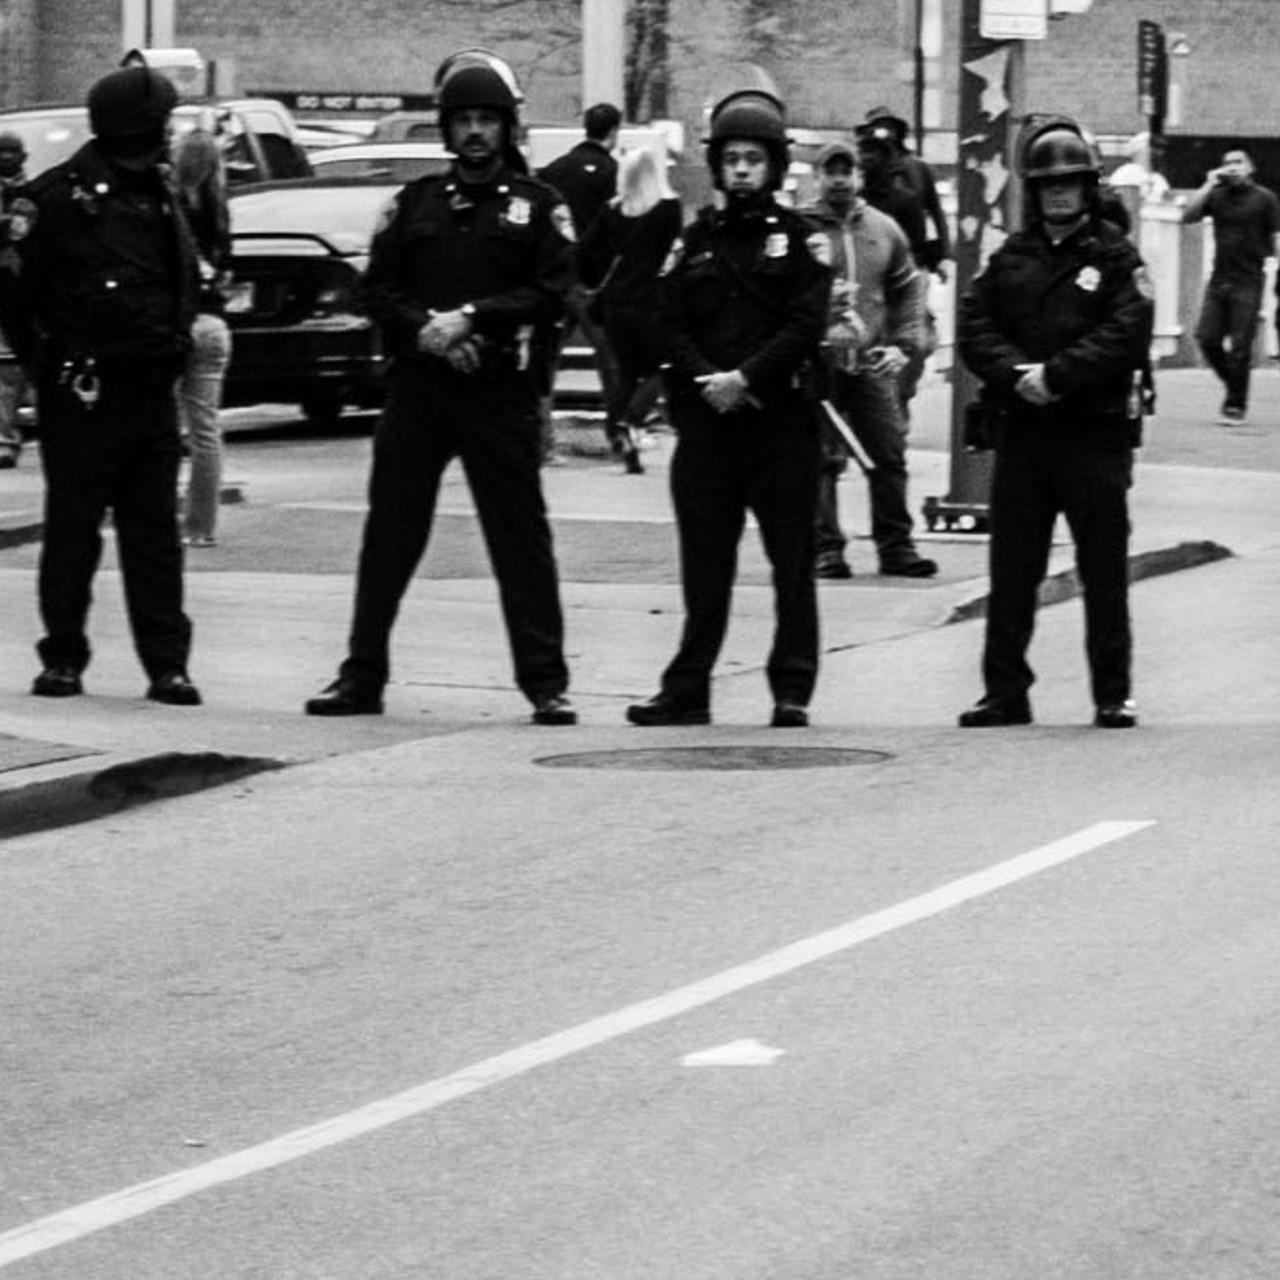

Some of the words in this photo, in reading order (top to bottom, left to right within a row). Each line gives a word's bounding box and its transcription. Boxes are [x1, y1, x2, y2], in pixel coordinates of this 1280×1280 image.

[297, 95, 319, 109] DO
[323, 95, 352, 109] NOT
[355, 95, 402, 110] ENTER
